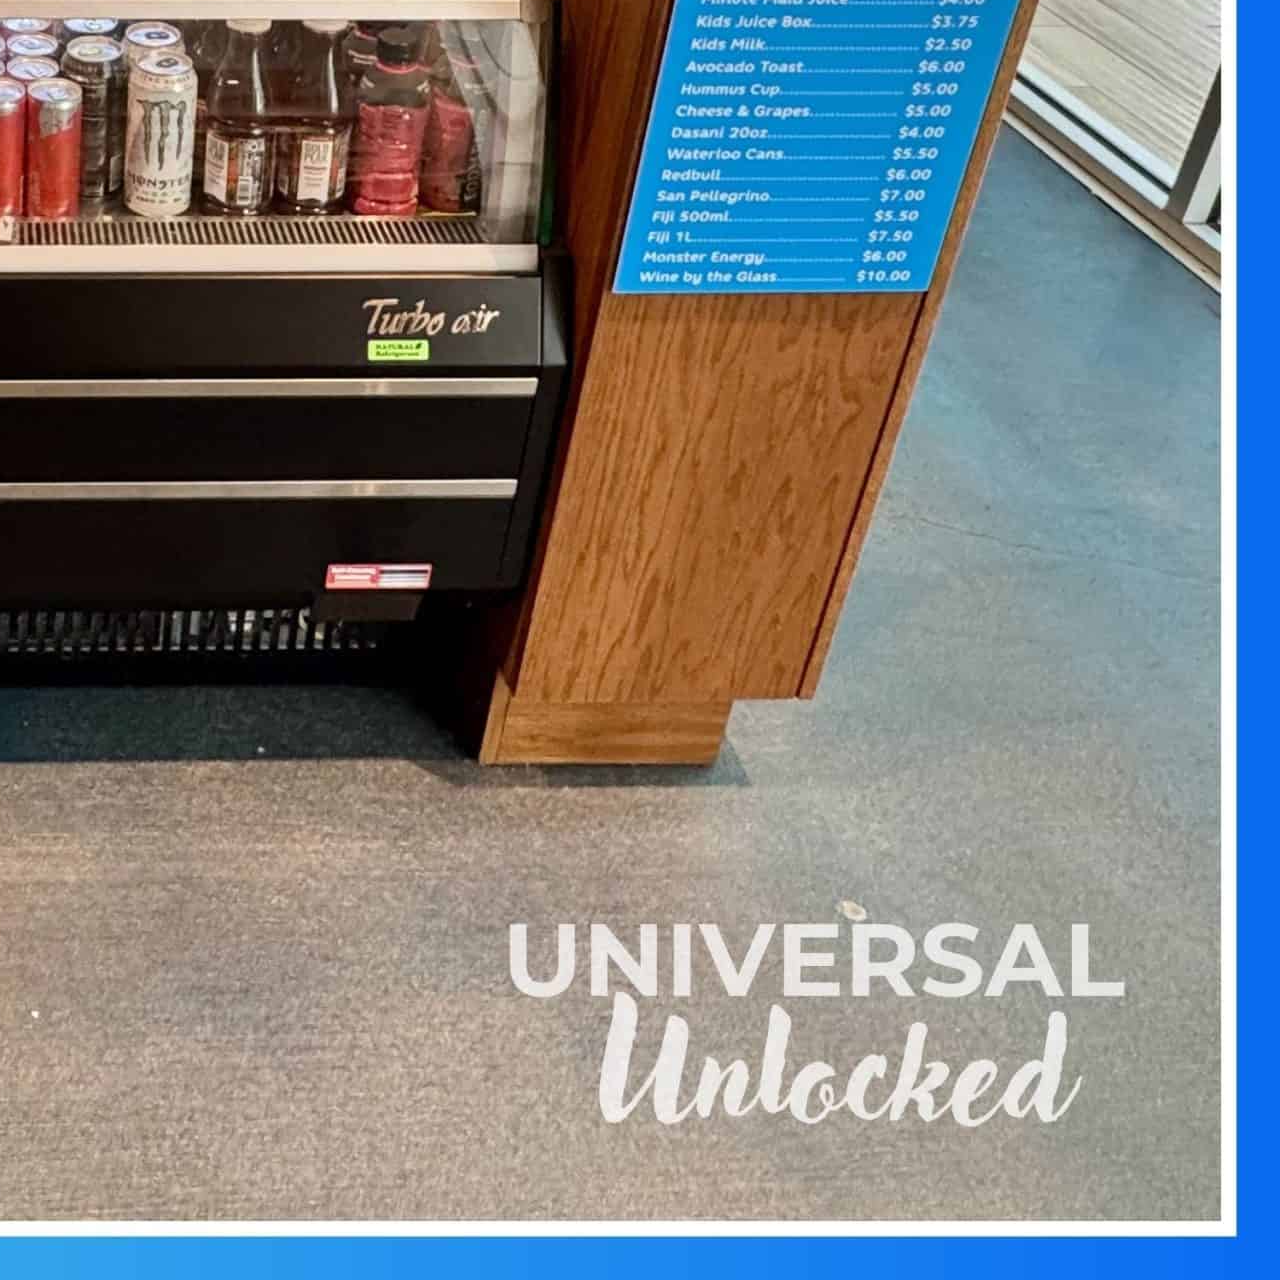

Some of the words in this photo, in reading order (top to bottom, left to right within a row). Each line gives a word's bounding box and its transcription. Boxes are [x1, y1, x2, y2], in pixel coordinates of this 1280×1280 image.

[696, 15, 732, 28] Kids
[735, 15, 778, 28] Juice
[781, 15, 812, 28] Box
[932, 14, 979, 29] $3.75
[691, 38, 726, 51] Kids
[730, 38, 766, 51] Milk
[925, 37, 972, 51] $2.50
[685, 61, 755, 73] Avocado
[761, 60, 804, 73] Toast
[918, 59, 965, 74] $6.00
[681, 83, 746, 96] Hummus
[750, 83, 780, 97] Cup
[912, 81, 958, 96] $5.00
[675, 104, 733, 117] Cheese
[737, 105, 750, 117] &
[753, 104, 810, 119] Grapes
[905, 104, 952, 118] $5.00
[671, 127, 724, 139] Dasani
[899, 125, 945, 139] $4.00
[667, 148, 742, 161] Waterloo
[745, 148, 786, 160] Cans
[893, 147, 939, 161] $5.50
[661, 169, 721, 181] Redbull
[887, 168, 932, 182] $6.00
[656, 190, 686, 202] San
[689, 190, 770, 205] Pellegrino
[880, 189, 925, 202] $7.00
[652, 210, 675, 225] Fiji
[874, 209, 920, 223] $5.50
[647, 231, 670, 244] Fiji
[868, 229, 913, 243] $7.50
[642, 251, 707, 263] Monster
[710, 251, 767, 266] Energy
[862, 250, 907, 263] $6.00
[639, 271, 680, 283] Wine
[682, 271, 703, 286] by
[707, 270, 733, 282] the
[735, 271, 777, 283] Glass
[857, 269, 911, 283] $10.00
[362, 298, 446, 335] Turbo
[451, 303, 500, 334] air
